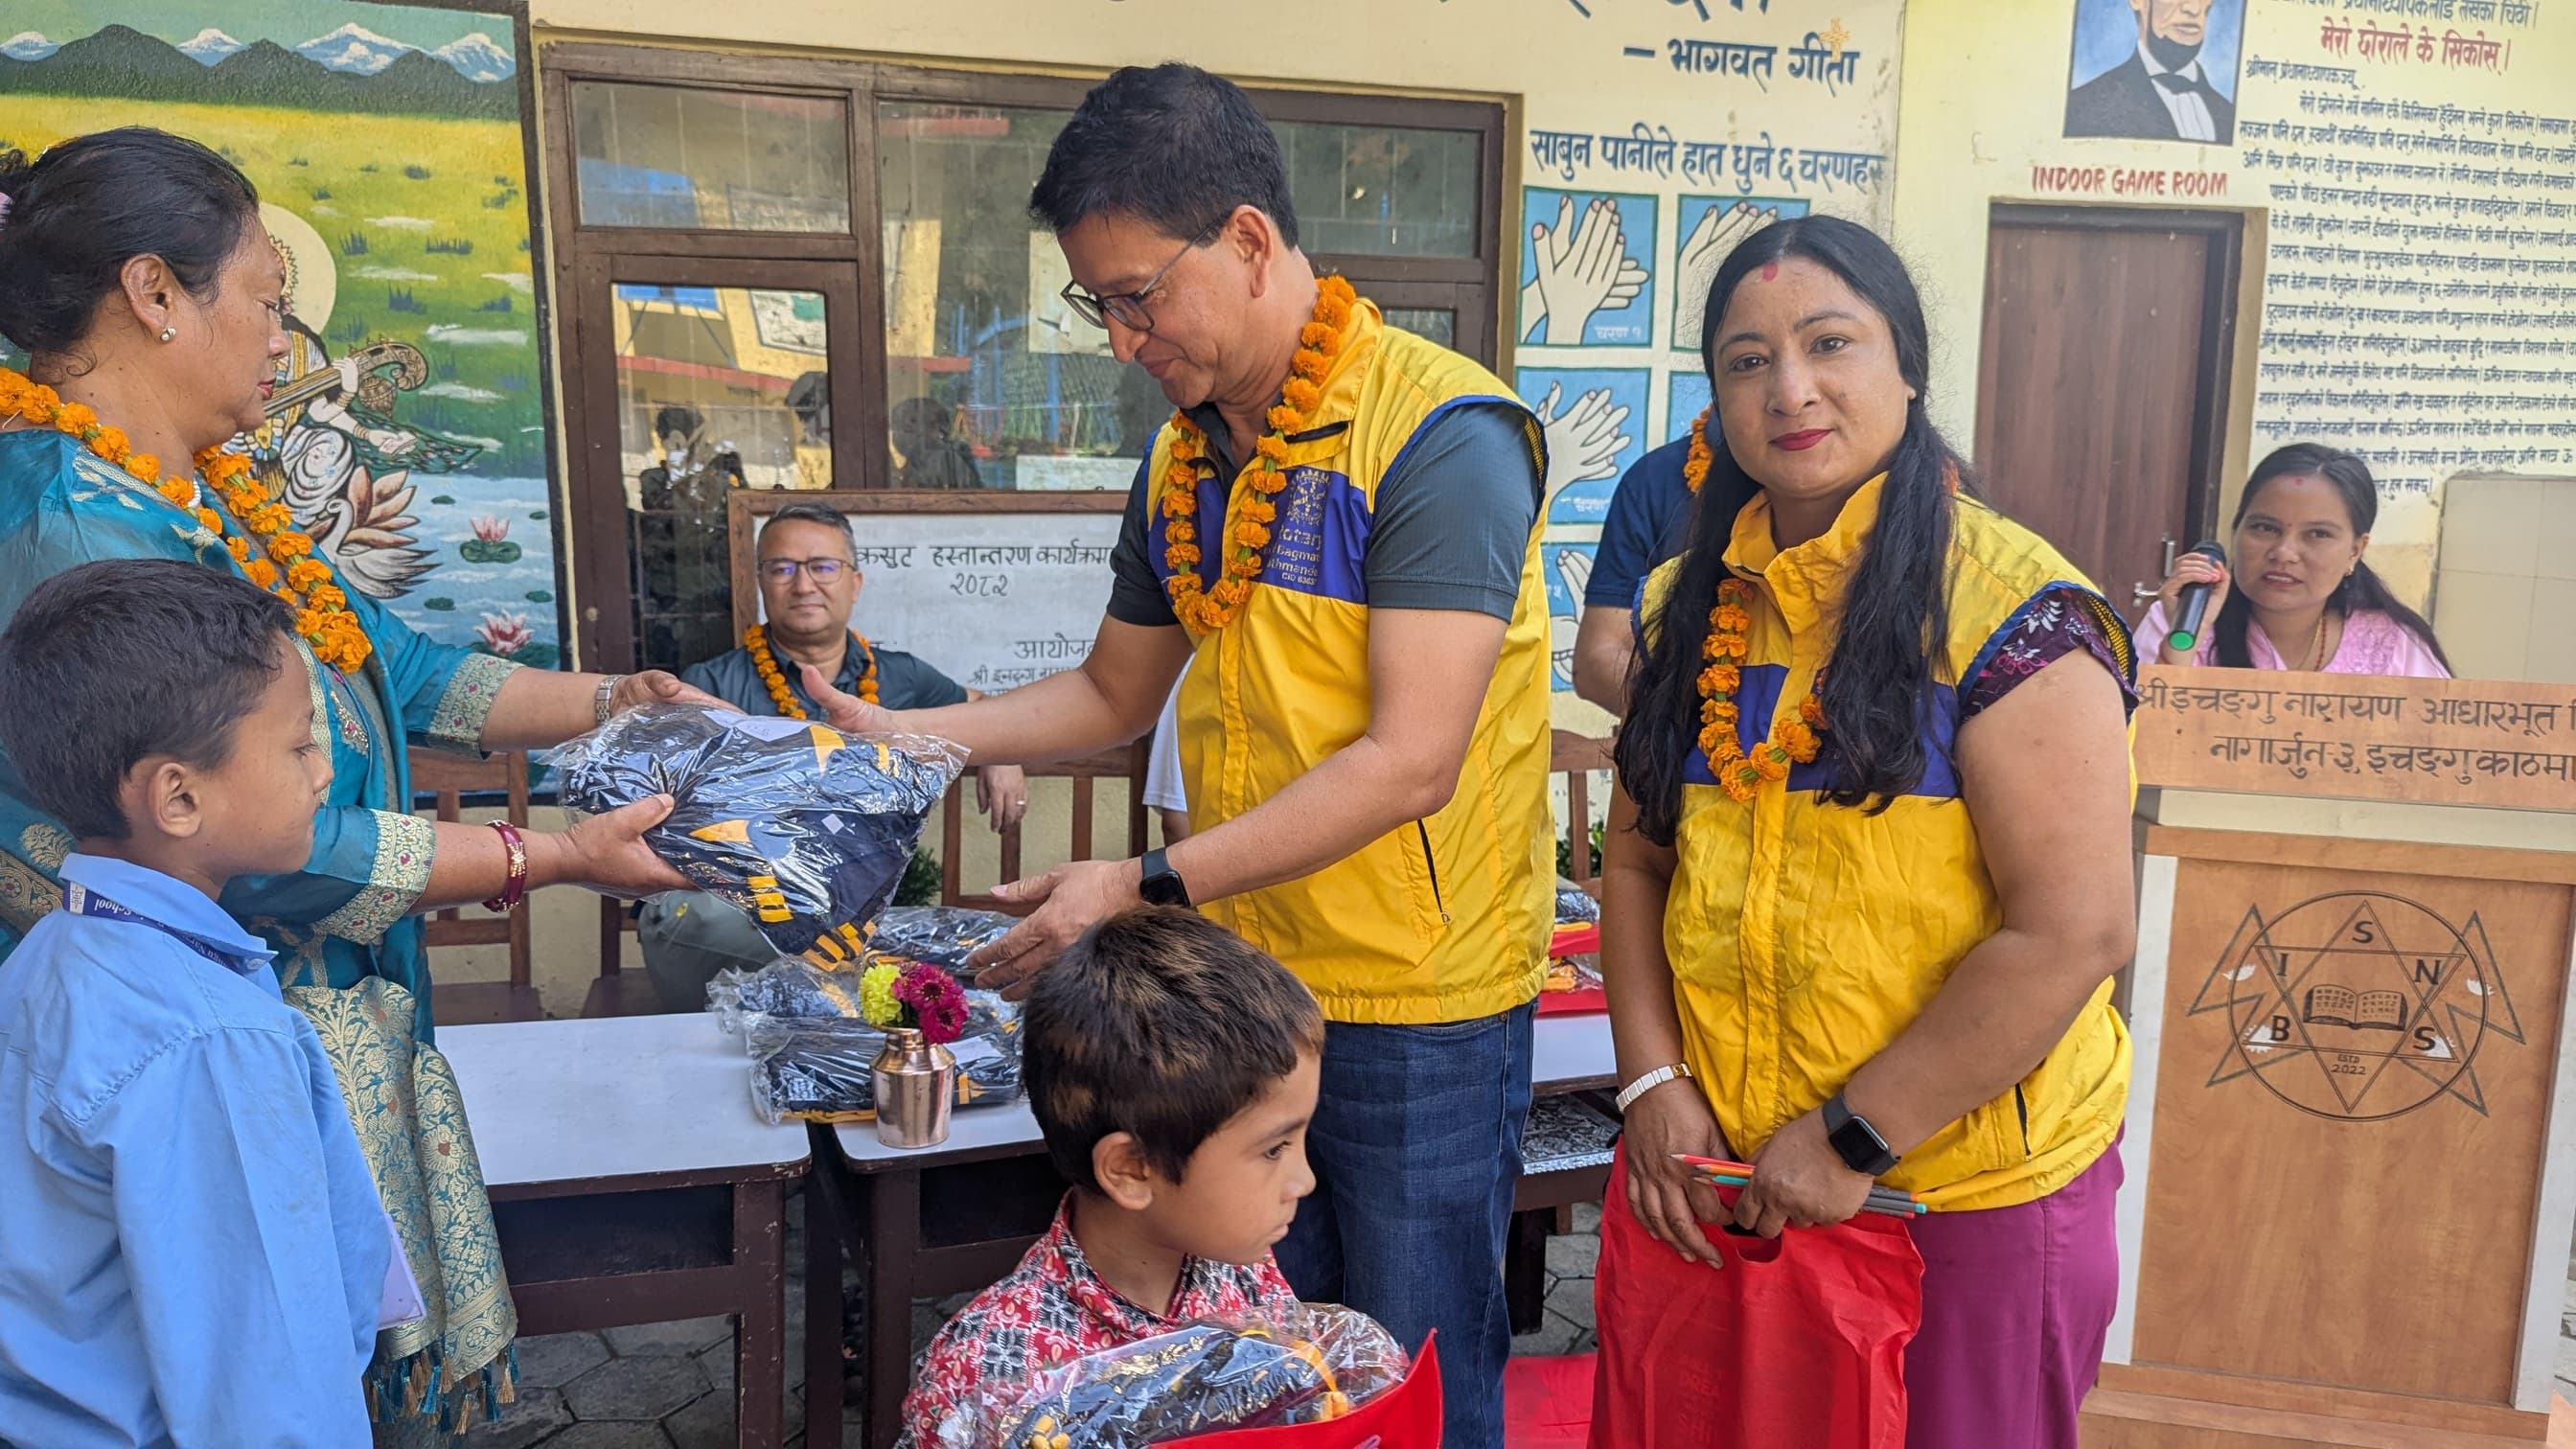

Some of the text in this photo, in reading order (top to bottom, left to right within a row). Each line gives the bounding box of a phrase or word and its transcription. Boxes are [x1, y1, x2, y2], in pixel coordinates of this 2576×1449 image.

[2321, 16, 2352, 58] मेरो
[2358, 19, 2413, 64] छोराले
[2416, 26, 2437, 63] के
[1668, 37, 1777, 92] भागवत
[1787, 32, 1860, 97] गीता
[2271, 118, 2290, 142] पनि
[1530, 129, 1593, 182] साबुन
[1599, 122, 1676, 176] पानीले
[1681, 142, 1727, 187] हात
[1731, 132, 1775, 196] धुने
[2032, 166, 2227, 197] INDOOR GAME ROOM
[856, 538, 1113, 569] कसुट हस्तान्तरण कार्यक्रम
[951, 572, 1009, 597] २०८२
[2284, 691, 2407, 723] नारायण
[2419, 698, 2562, 737] आधारभूत
[2476, 749, 2576, 781] काठमा
[2353, 920, 2374, 944] S
[2276, 953, 2441, 985] I N
[2270, 1015, 2437, 1052] B S
[2331, 1064, 2366, 1076] 2022
